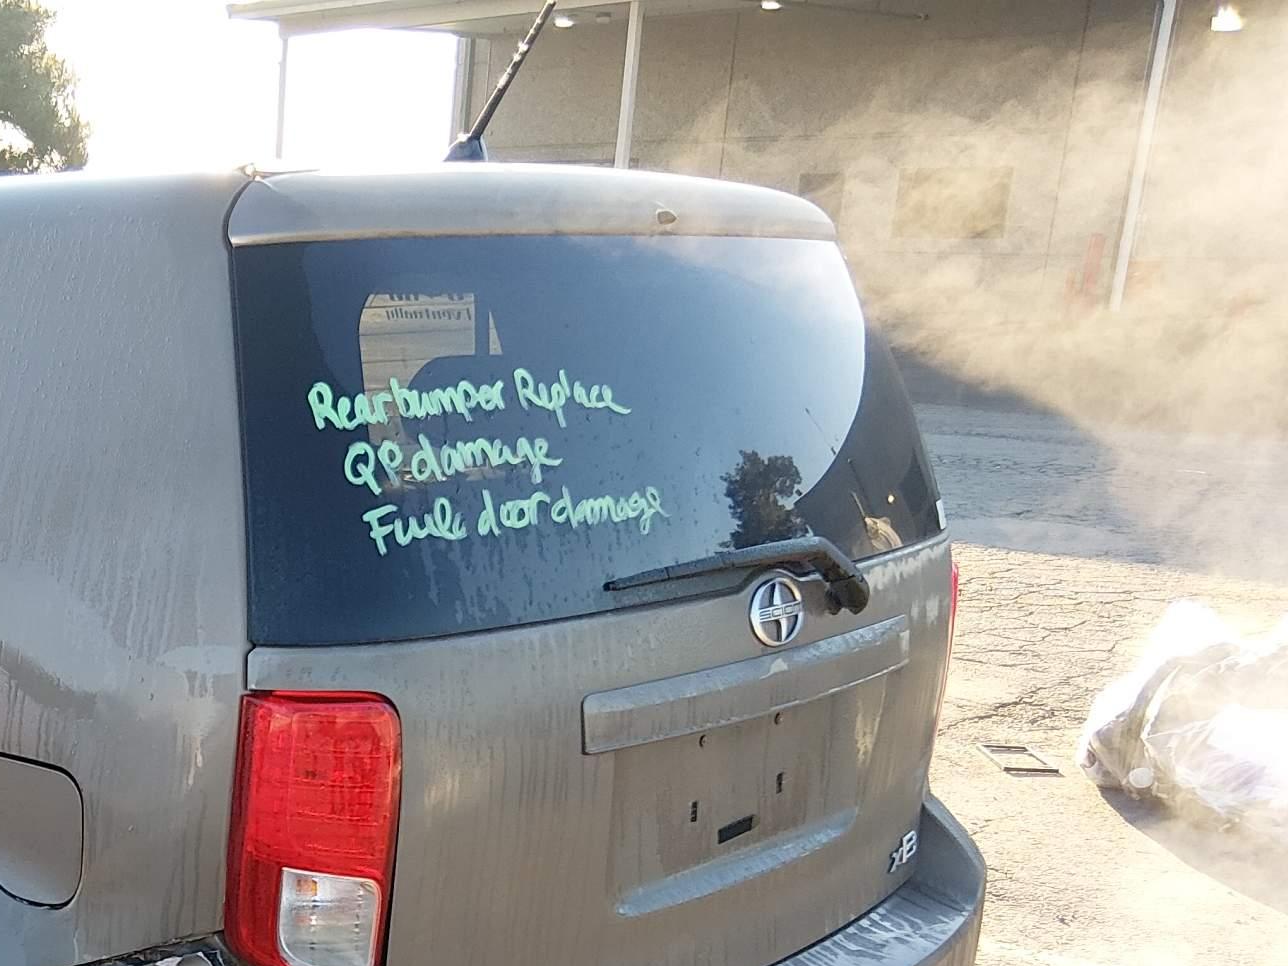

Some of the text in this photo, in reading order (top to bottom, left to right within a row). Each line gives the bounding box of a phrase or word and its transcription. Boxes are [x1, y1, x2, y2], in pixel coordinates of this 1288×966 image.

[411, 433, 564, 484] damage
[477, 488, 551, 537] door
[550, 485, 671, 536] damage
